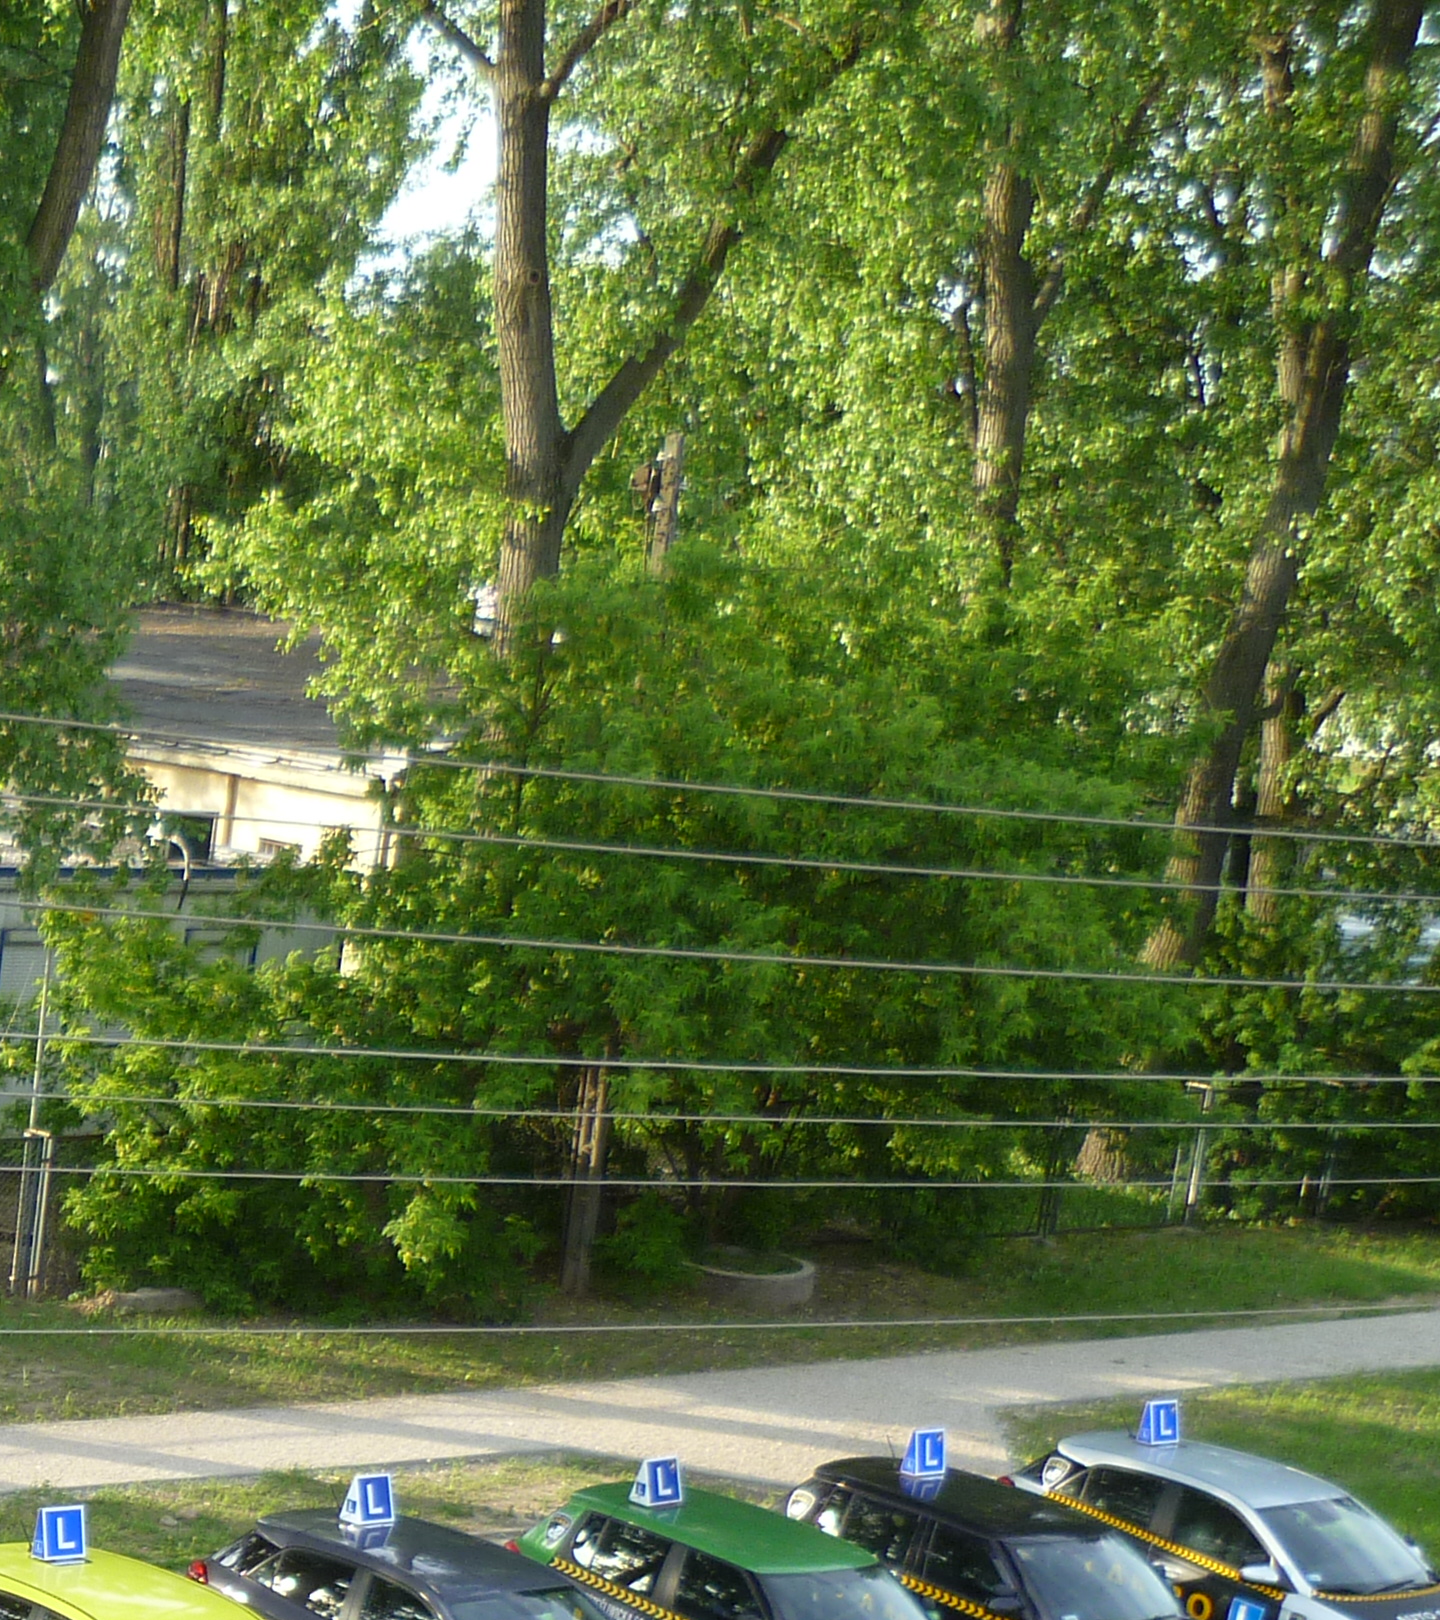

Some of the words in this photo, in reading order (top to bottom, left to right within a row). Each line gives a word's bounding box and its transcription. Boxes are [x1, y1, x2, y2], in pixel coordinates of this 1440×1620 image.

[1160, 1407, 1173, 1435] L
[925, 1437, 938, 1466] L
[656, 1466, 672, 1496] L
[365, 1482, 385, 1515] L
[56, 1516, 76, 1550] L
